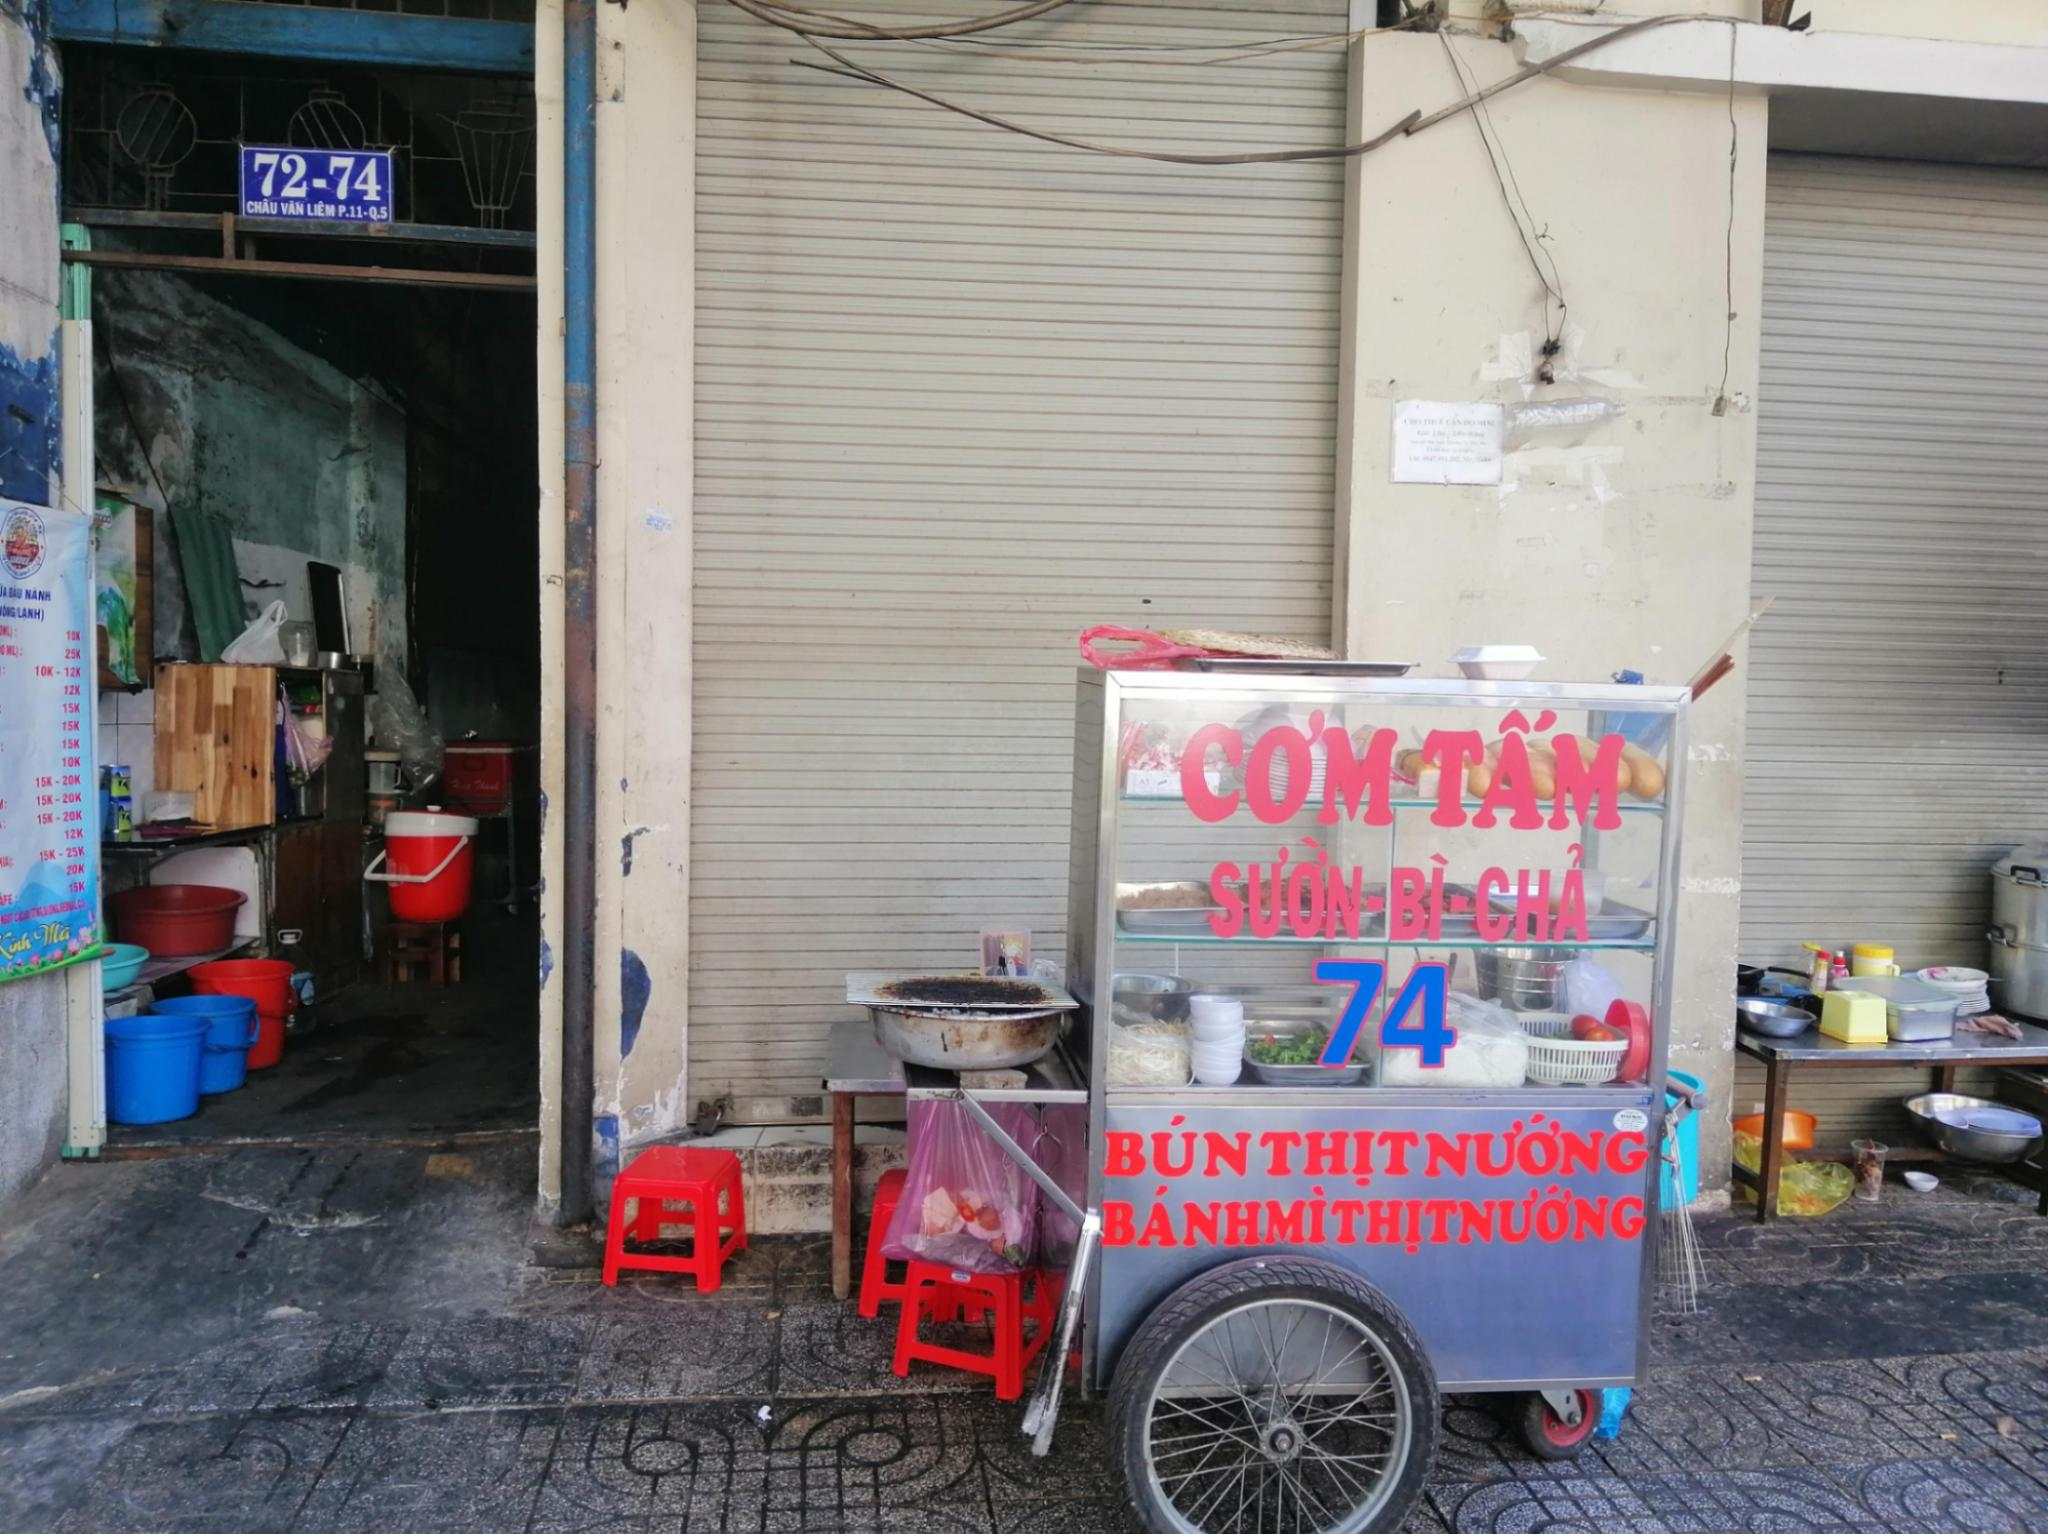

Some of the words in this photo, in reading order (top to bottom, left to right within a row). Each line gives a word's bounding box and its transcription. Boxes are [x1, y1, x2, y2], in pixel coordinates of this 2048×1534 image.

[254, 153, 382, 201] 72-74
[247, 199, 278, 214] CHÂU
[281, 201, 304, 216] VĂN
[307, 201, 335, 218] LIÊM
[66, 630, 80, 641] 10K
[64, 648, 80, 659] 25K
[35, 665, 54, 677] 10K
[64, 667, 80, 678] 12K
[64, 685, 80, 696] 12K
[62, 703, 80, 714] 15K
[62, 721, 80, 732] 15K
[62, 739, 80, 750] 15K
[62, 757, 80, 768] 10K
[1180, 709, 1398, 826] CƠM
[1422, 709, 1627, 830] TẤM
[36, 776, 53, 788] 15K
[63, 775, 81, 786] 20K
[37, 795, 53, 806] 15K
[62, 792, 81, 803] 20K
[37, 813, 54, 825] 15K
[63, 810, 82, 821] 20K
[64, 828, 83, 839] 12K
[40, 850, 56, 862] 15K
[66, 846, 85, 858] 25K
[66, 864, 85, 876] 20K
[69, 881, 85, 893] 15K
[1313, 958, 1457, 1069] 74
[1104, 1115, 1253, 1178] BÚN
[1260, 1129, 1419, 1186] THỊT
[1425, 1114, 1649, 1177] NƯỚNG
